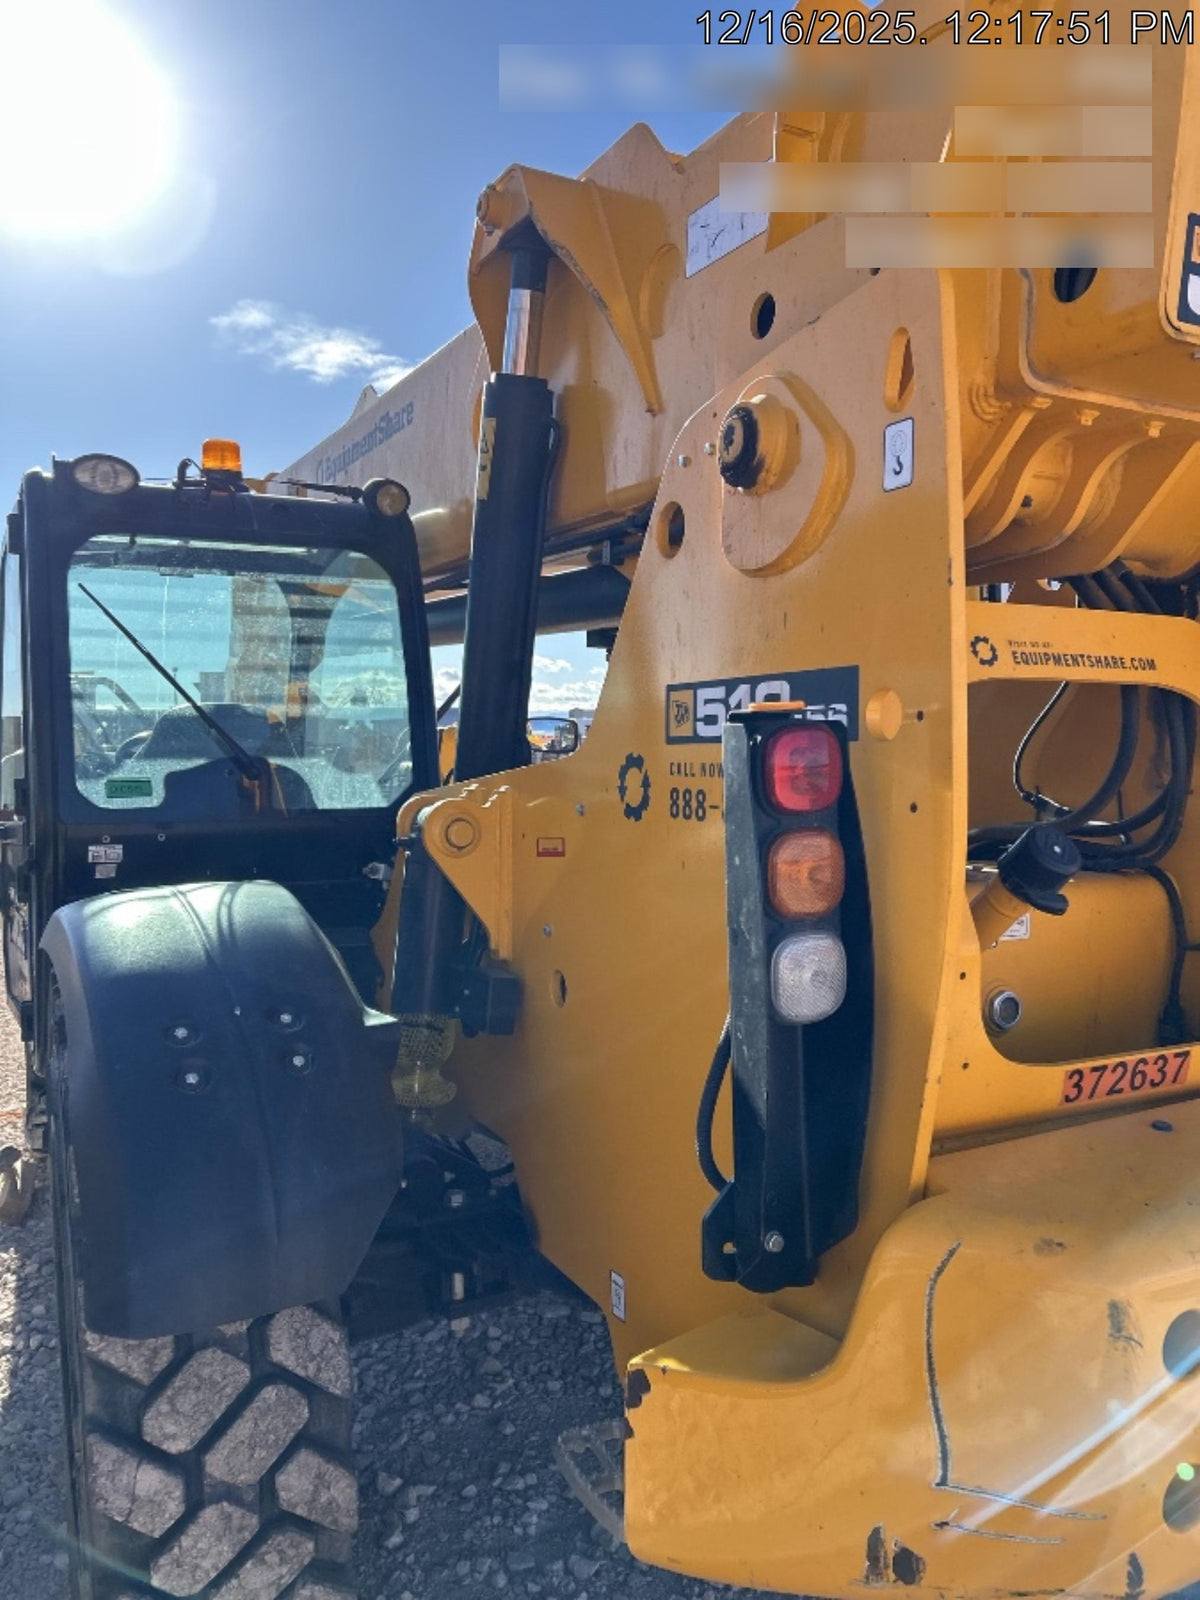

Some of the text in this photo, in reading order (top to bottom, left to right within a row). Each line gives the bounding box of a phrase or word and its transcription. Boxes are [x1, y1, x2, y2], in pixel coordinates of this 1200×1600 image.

[1012, 651, 1157, 671] EQUIPMENTSHARE.COM
[669, 762, 696, 777] CALL
[1064, 1050, 1190, 1104] 372637
